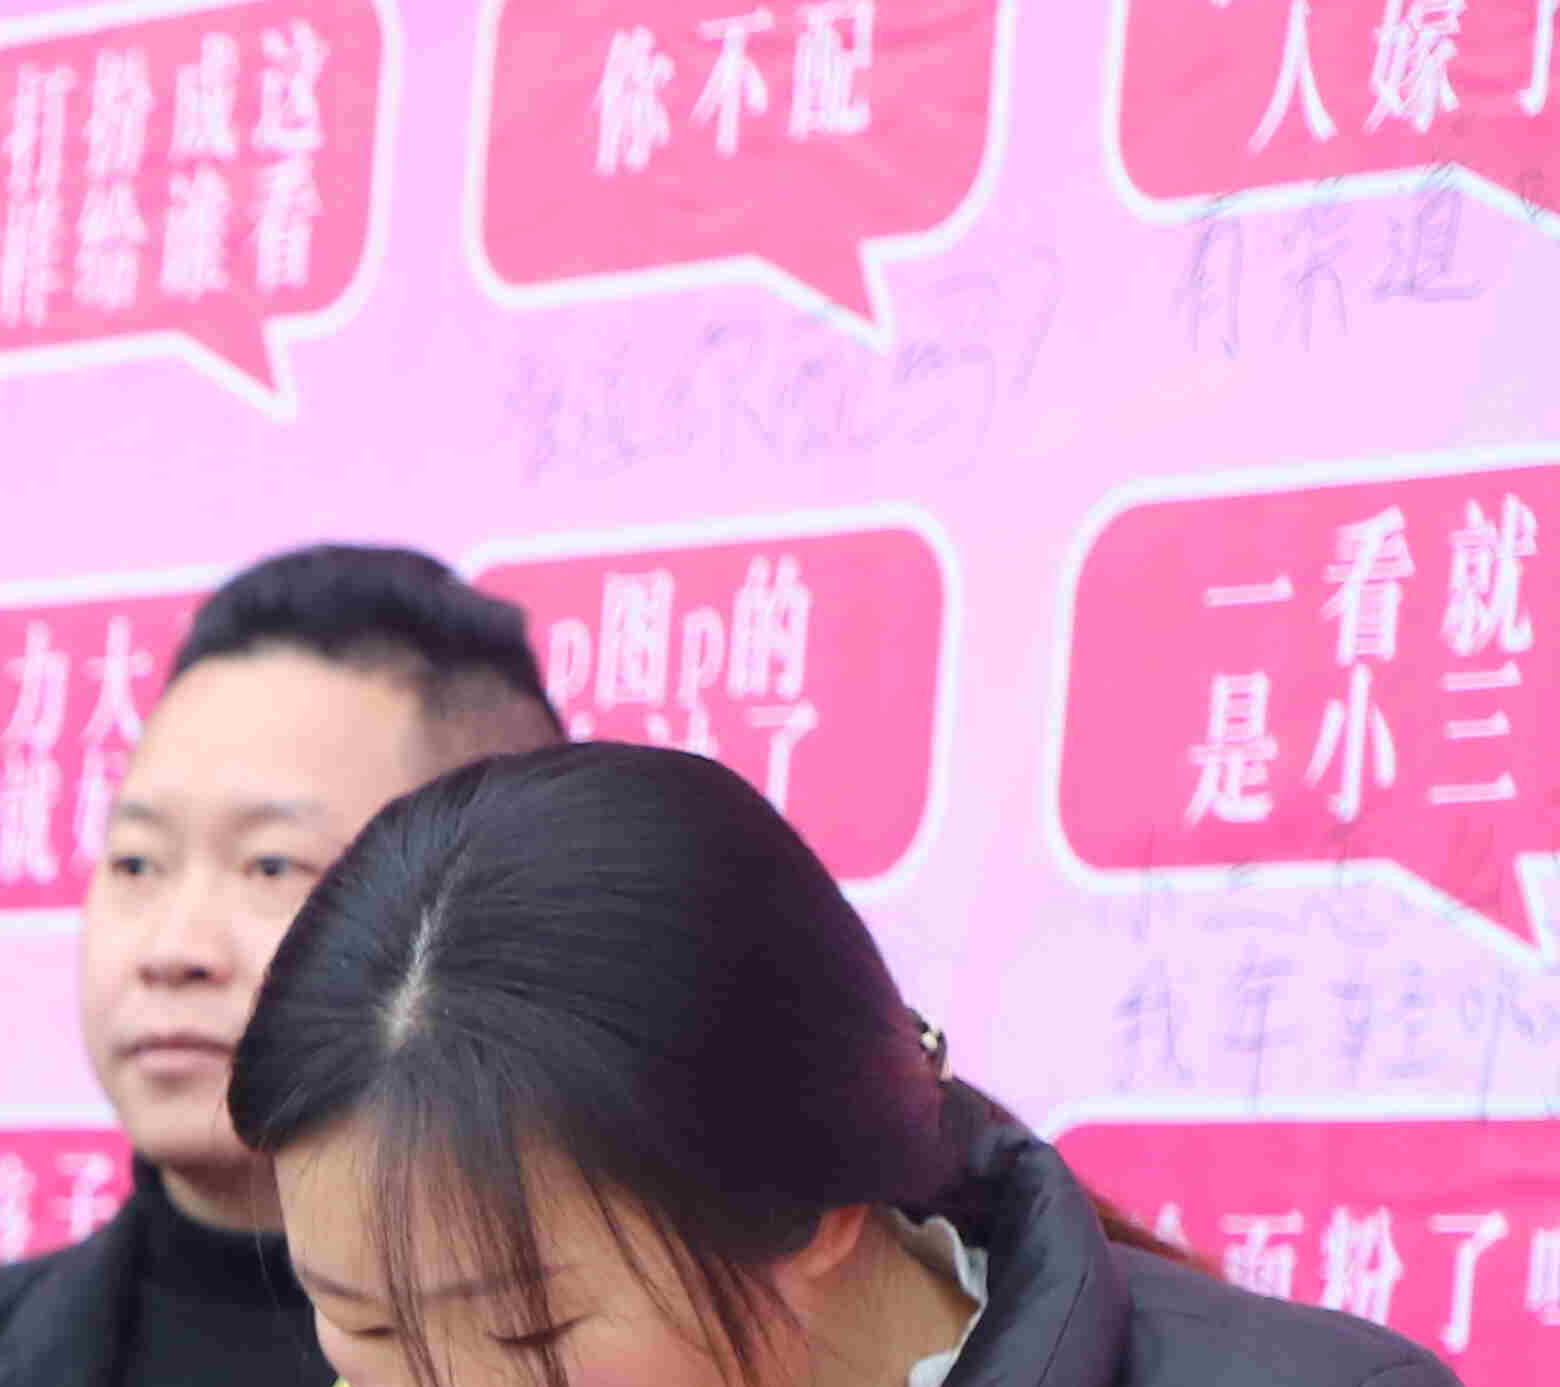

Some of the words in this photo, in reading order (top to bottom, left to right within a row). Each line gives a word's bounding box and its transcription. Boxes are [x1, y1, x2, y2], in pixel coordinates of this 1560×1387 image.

[3, 18, 328, 197] 打扮成这
[590, 2, 876, 175] 你不配
[1202, 492, 1538, 665] 一看就
[1182, 662, 1522, 830] 是小三
